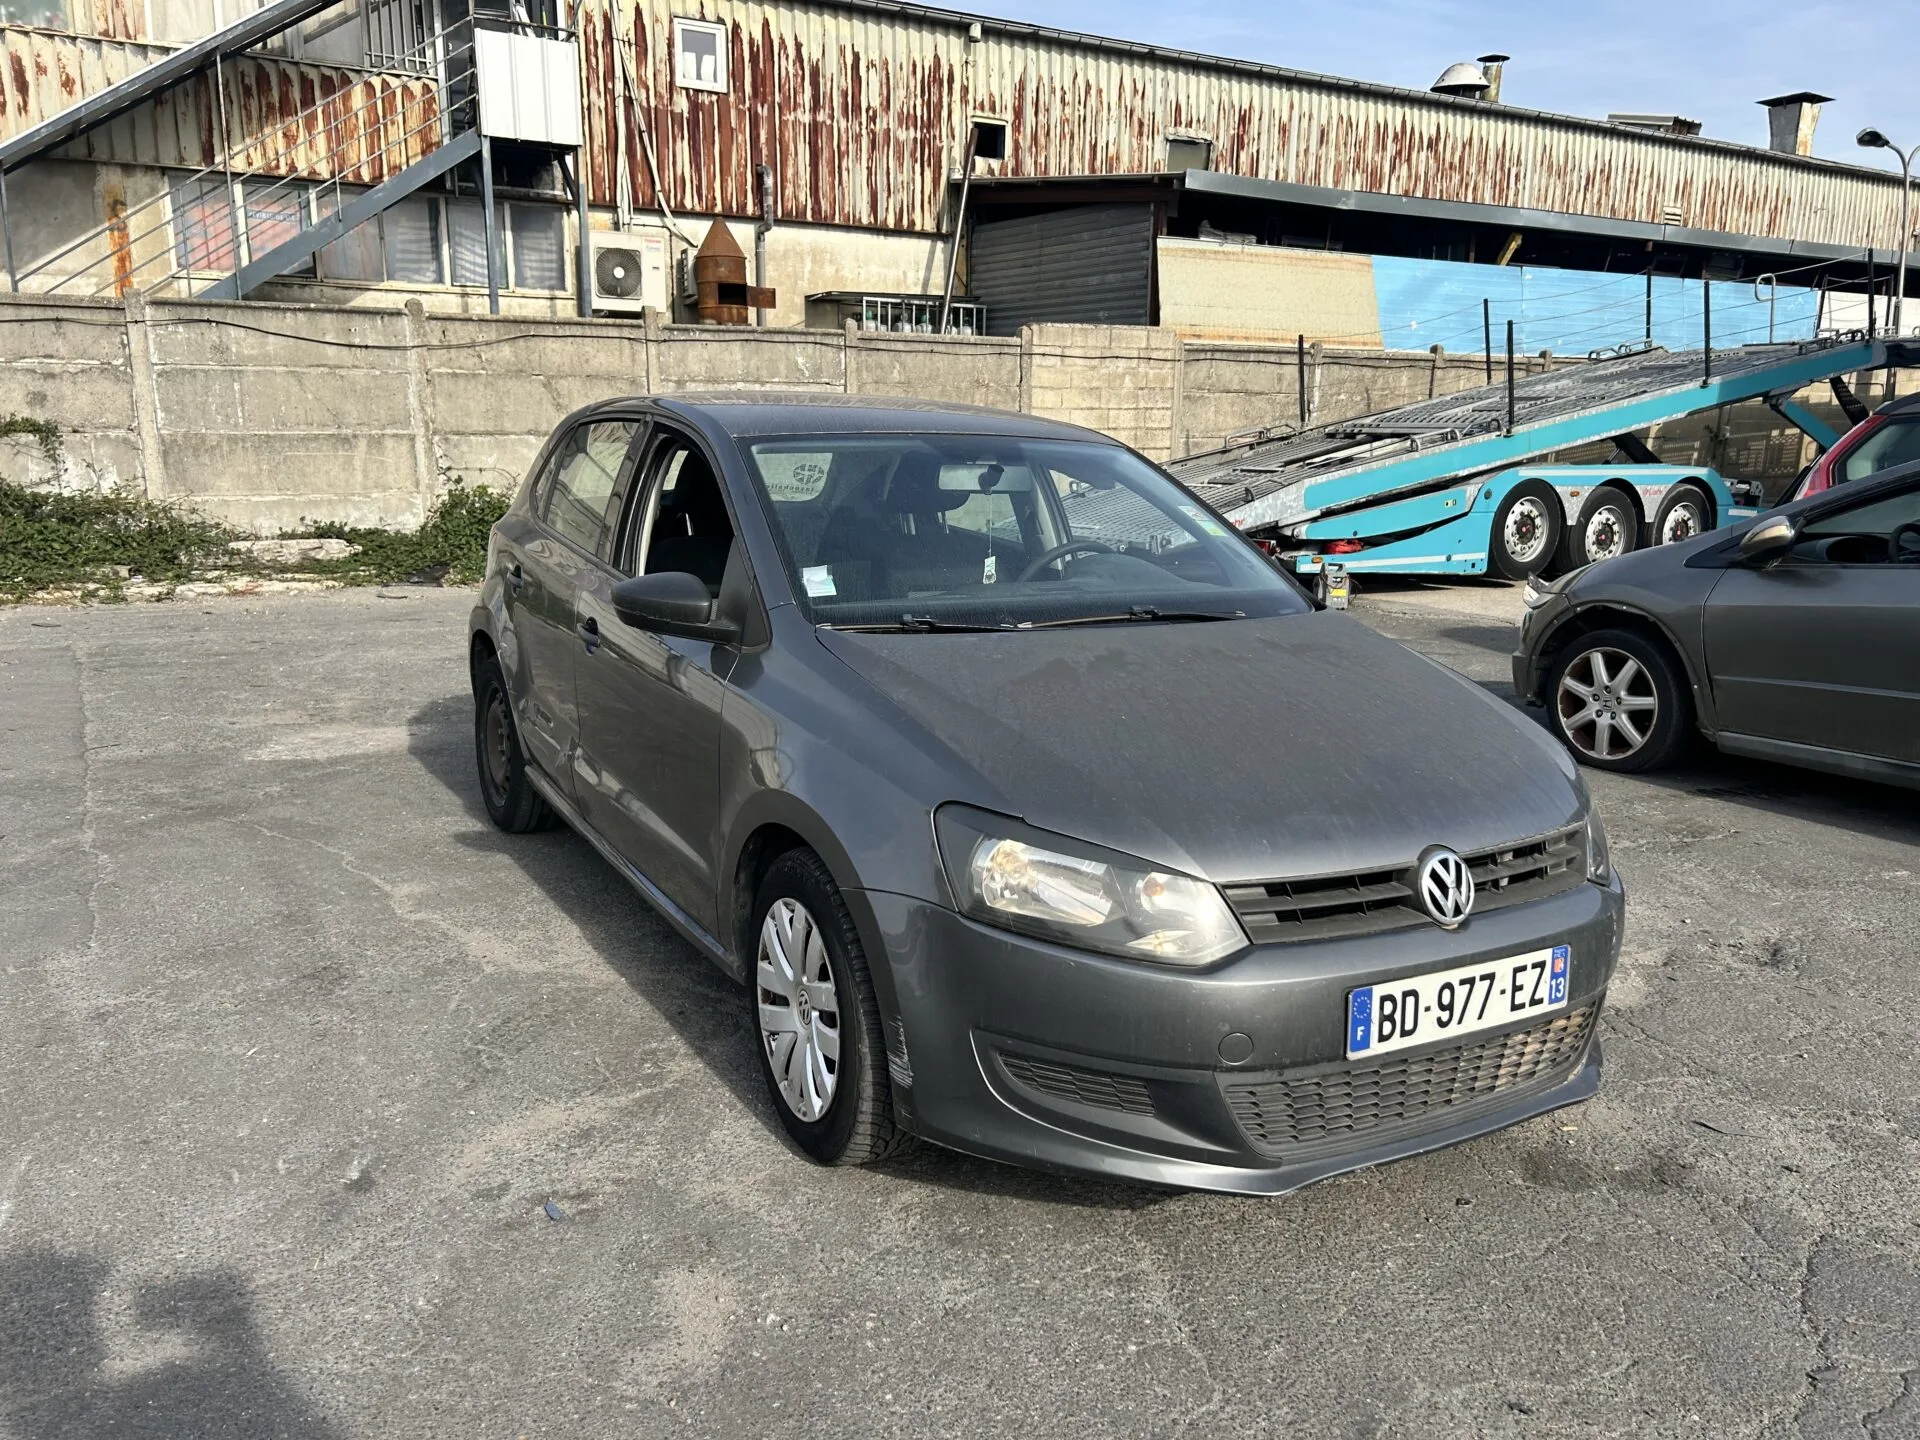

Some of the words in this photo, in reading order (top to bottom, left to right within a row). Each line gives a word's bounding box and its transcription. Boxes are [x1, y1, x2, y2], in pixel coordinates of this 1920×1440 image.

[1550, 976, 1565, 999] 13
[1377, 960, 1547, 1043] BD-977-EZ
[1356, 1026, 1364, 1041] F
